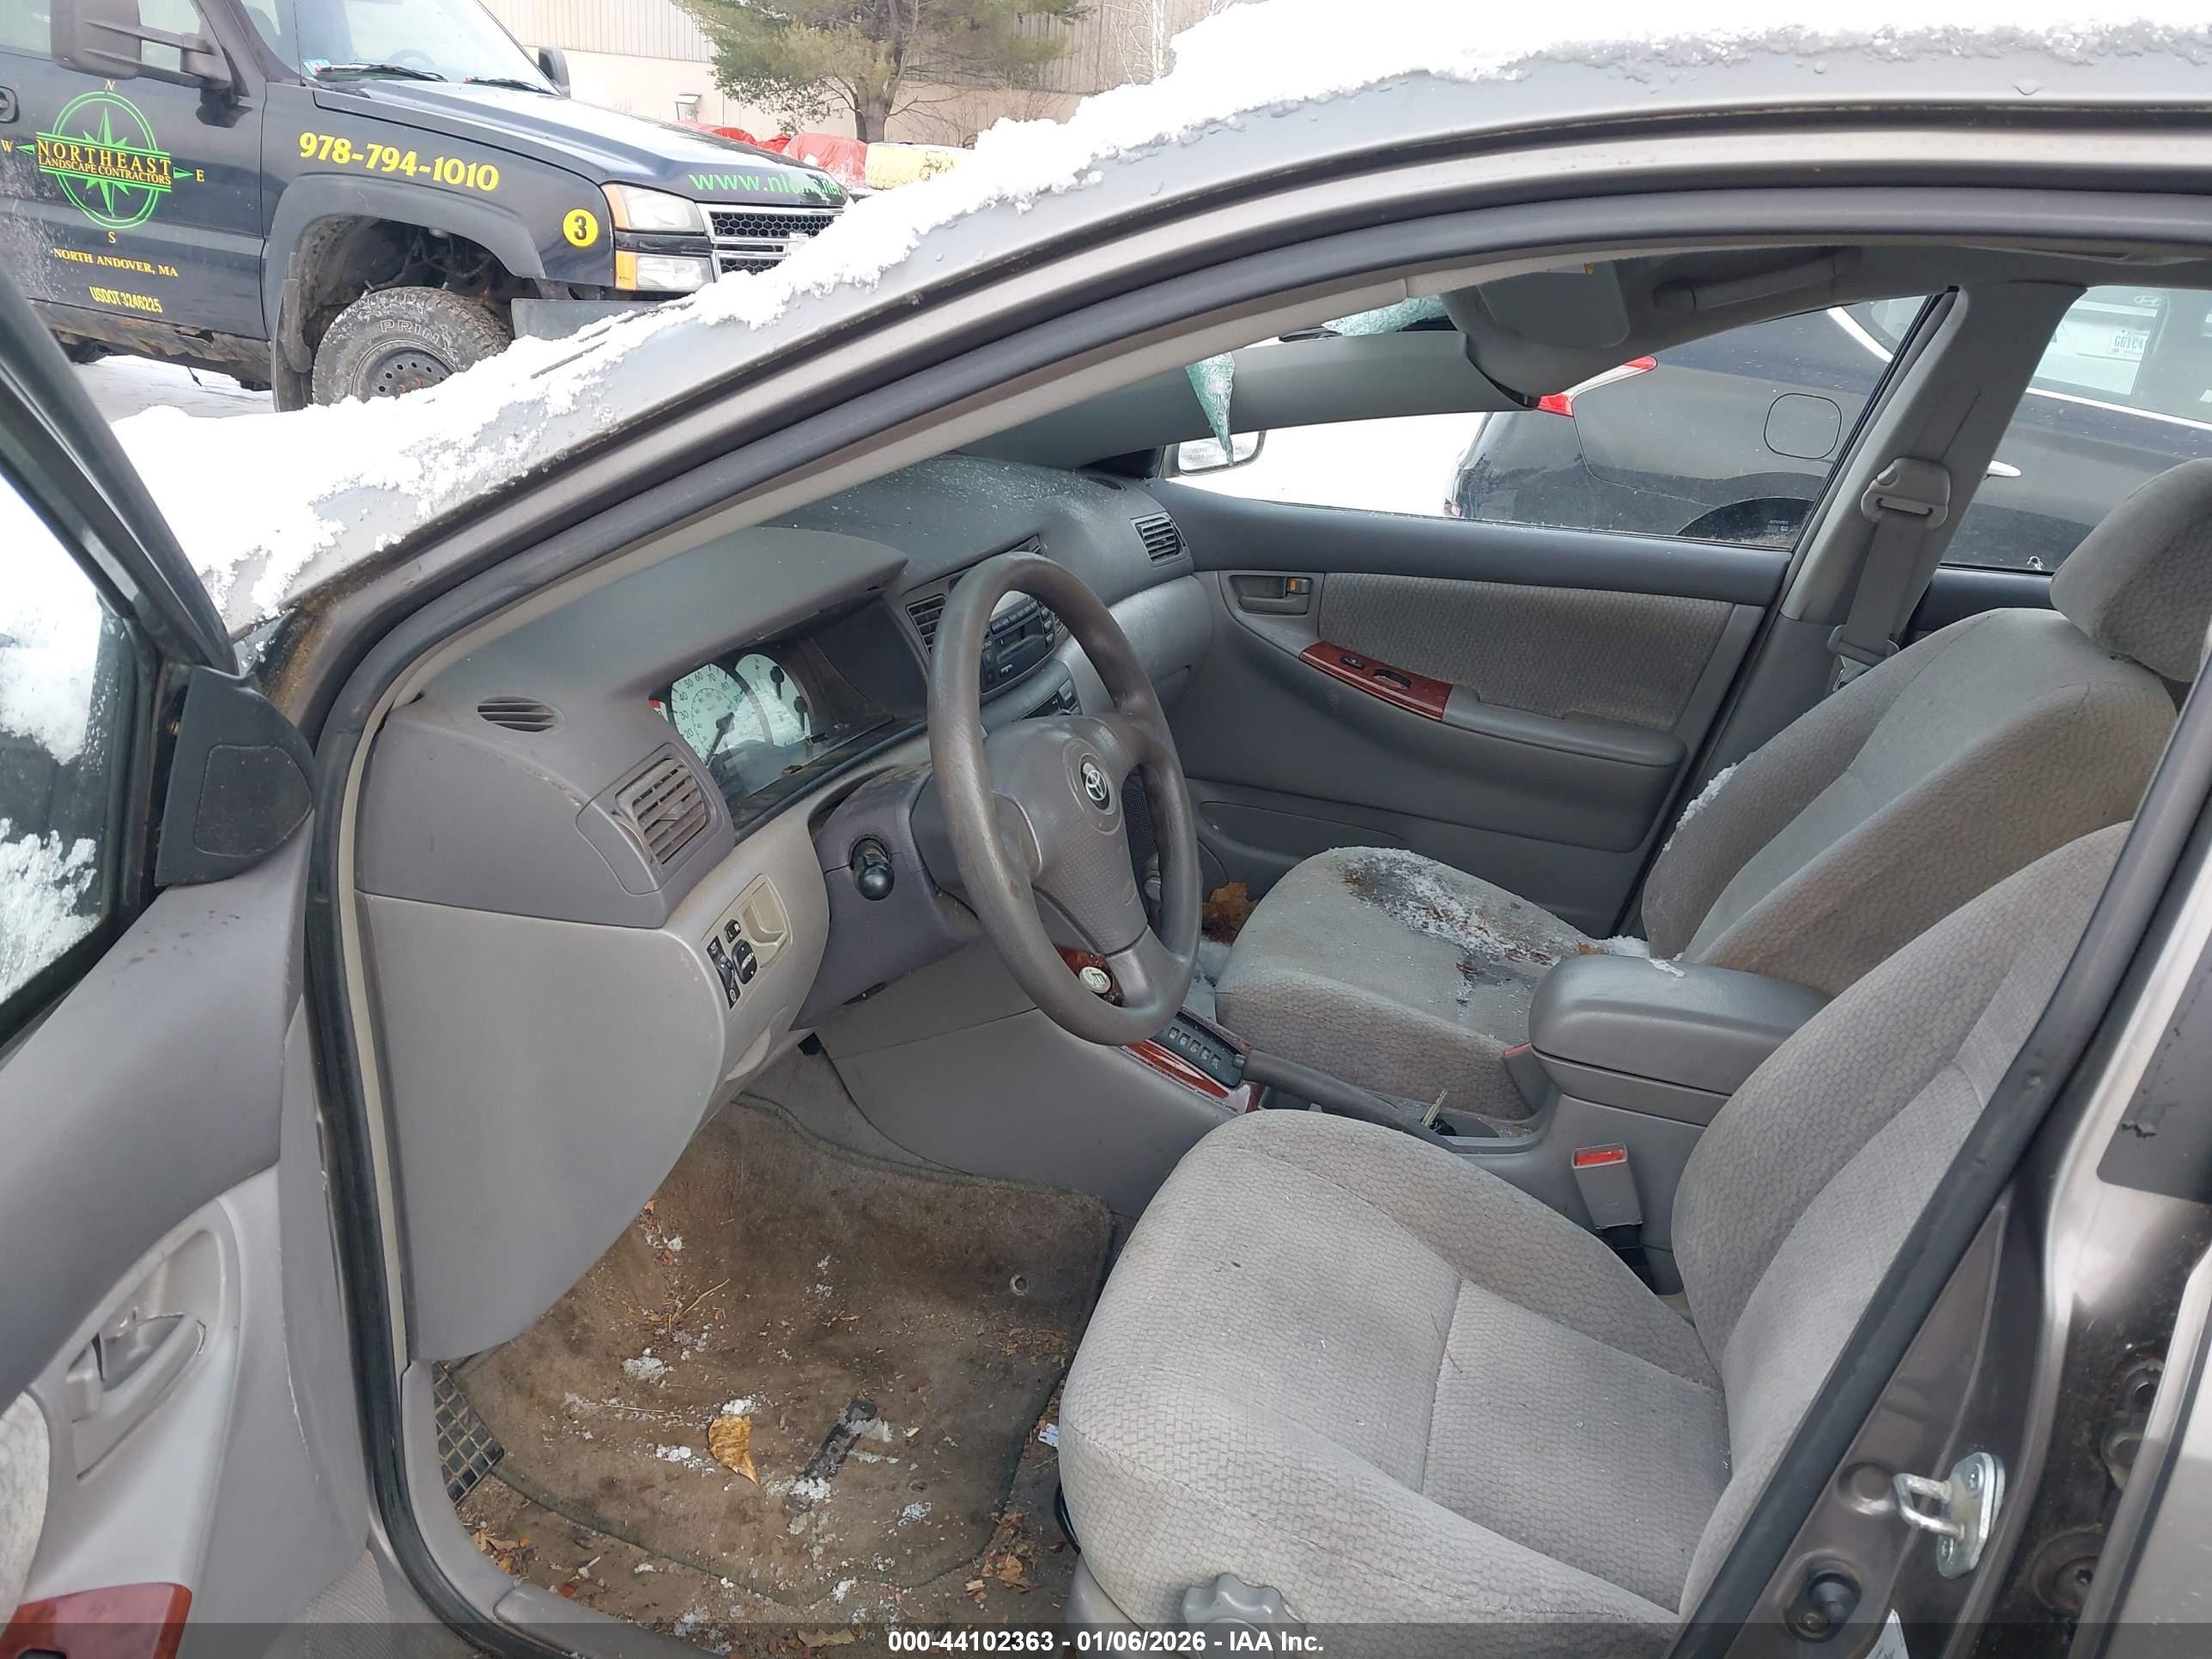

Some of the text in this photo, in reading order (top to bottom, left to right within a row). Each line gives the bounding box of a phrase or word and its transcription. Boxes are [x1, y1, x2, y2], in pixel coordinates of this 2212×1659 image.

[105, 80, 116, 91] N
[1, 141, 13, 153] W
[37, 139, 171, 176] NORTHEAST
[299, 131, 500, 191] 978-794-1010
[38, 155, 172, 185] LANDSCAPE CONTRACTORS
[196, 169, 204, 182] E
[574, 216, 587, 240] 3
[108, 231, 117, 244] S
[53, 247, 179, 277] NORTH ANDOVER, MA
[88, 286, 163, 313] USDOT 3246225
[684, 678, 694, 689] 50
[679, 692, 687, 701] 40
[679, 709, 689, 720] 30
[684, 728, 694, 738] 20
